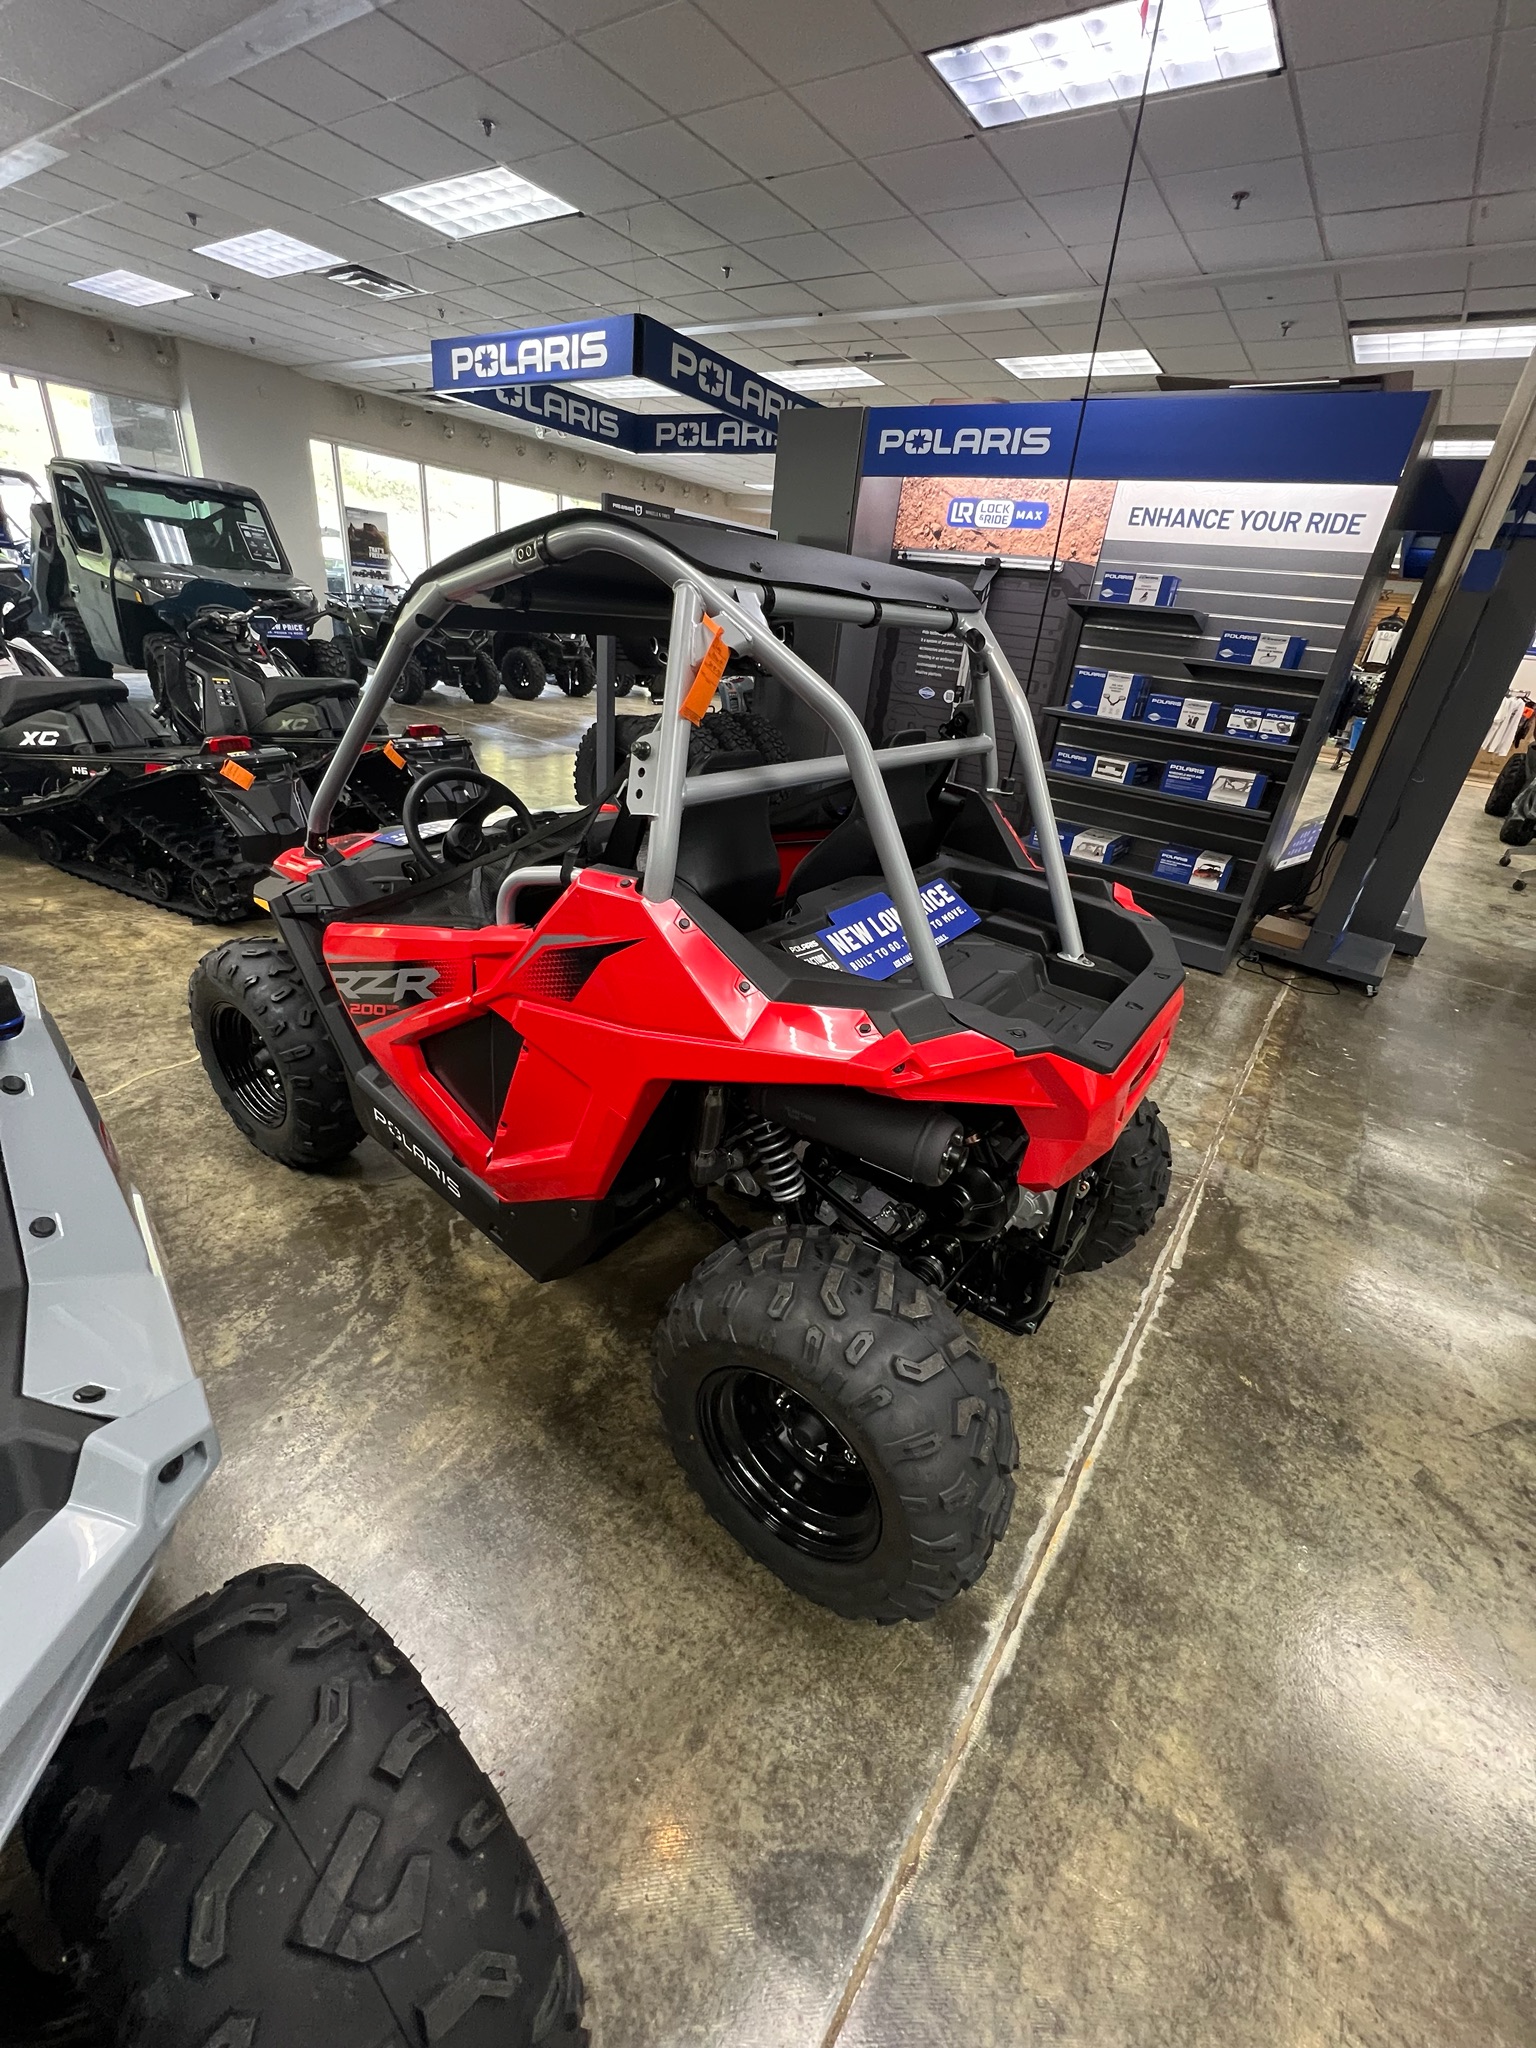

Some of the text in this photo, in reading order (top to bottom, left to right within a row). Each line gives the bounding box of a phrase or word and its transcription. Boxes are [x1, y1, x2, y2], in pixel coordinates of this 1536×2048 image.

[451, 330, 608, 380] POLARIS
[670, 342, 800, 423] POLAR
[494, 385, 620, 439] OLARIS
[655, 421, 778, 447] POLARI
[878, 427, 1052, 455] POLARIS
[950, 502, 974, 525] LR
[980, 503, 1011, 514] LOCK
[1015, 510, 1043, 521] MAX
[1128, 506, 1367, 536] ENHANCE YOUR RIDE
[1104, 573, 1134, 581] POLARIS
[282, 623, 304, 632] PRICE
[1223, 632, 1258, 642] POLARIS
[1079, 670, 1106, 678] POLARIS
[1151, 698, 1182, 707] POLARIS
[1234, 708, 1262, 716] POLARIS
[1266, 713, 1295, 721] POLARIS
[277, 718, 310, 731] XC
[19, 731, 60, 746] XC
[1057, 751, 1087, 762] POLARIS
[1169, 764, 1205, 775] POLARIS
[1161, 853, 1188, 863] POLARIS
[826, 921, 875, 956] NEW
[849, 953, 876, 972] BUILT
[874, 947, 889, 959] TO
[887, 940, 904, 953] GO.
[930, 918, 943, 929] TO
[941, 906, 967, 923] MOVE.
[788, 940, 819, 953] POLARIS
[330, 967, 441, 1003] RZR
[349, 1003, 387, 1016] 200
[373, 1107, 461, 1198] POLARIS
